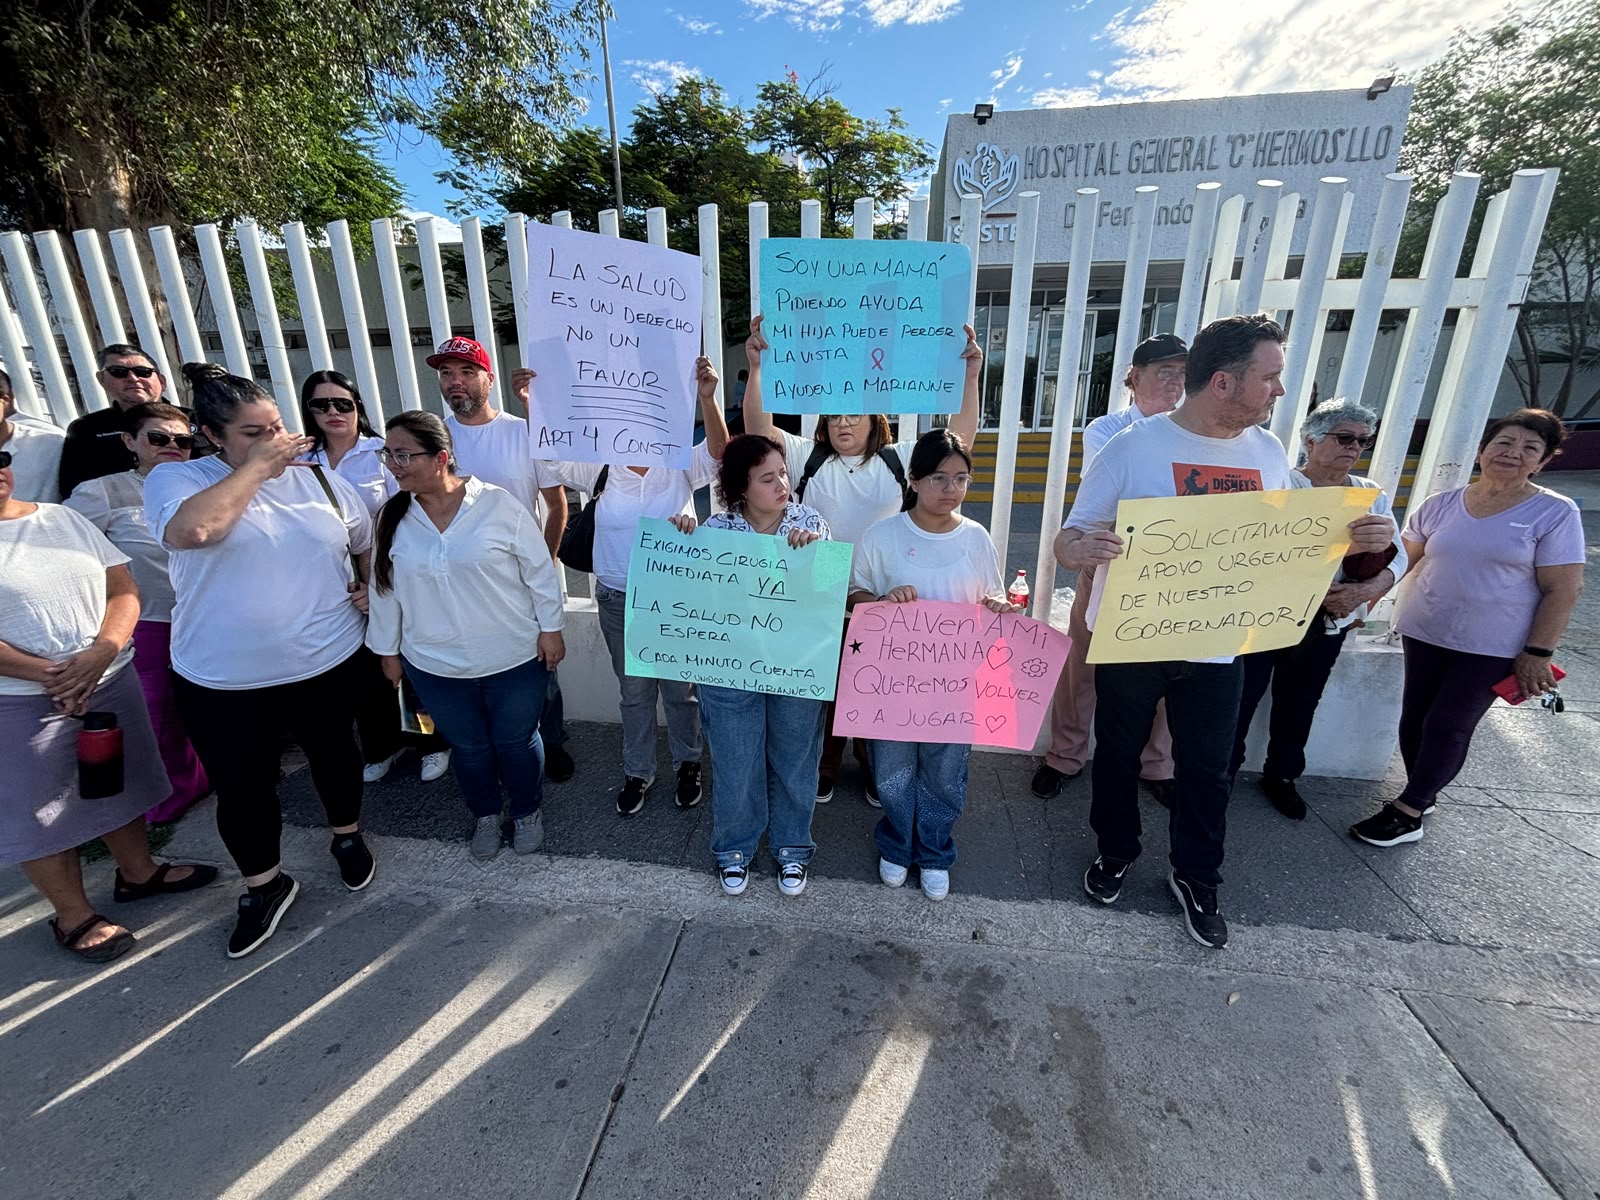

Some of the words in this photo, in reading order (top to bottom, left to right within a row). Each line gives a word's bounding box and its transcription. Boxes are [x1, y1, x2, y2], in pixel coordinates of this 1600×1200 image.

[1024, 141, 1121, 179] HOSPITAL
[1128, 135, 1219, 175] GENERAL
[1098, 198, 1194, 228] Ferndo
[549, 247, 586, 281] LA
[597, 265, 686, 301] SALUD
[775, 252, 819, 278] SOY
[827, 260, 866, 278] UNA
[873, 254, 947, 279] MAMÁ
[552, 291, 578, 308] ES
[591, 298, 613, 315] UN
[624, 306, 694, 333] DERECHO
[775, 288, 847, 312] PIDIENDO
[859, 295, 923, 312] AYUDA
[566, 325, 593, 342] NO
[610, 333, 639, 348] UN
[773, 324, 792, 339] MI
[801, 324, 836, 340] HIJA
[842, 323, 889, 339] PUEDE
[901, 324, 956, 339] PERDER
[774, 347, 796, 364] LA
[801, 347, 848, 364] VISTA
[577, 360, 668, 392] FAVOR
[775, 379, 832, 400] AYUDEN
[844, 380, 854, 394] A
[864, 377, 955, 393] MARIANNE
[538, 425, 574, 448] ART
[583, 425, 598, 452] 4
[640, 530, 712, 562] EXIGIMOS
[716, 551, 788, 573] CIRUGIA
[1126, 516, 1330, 560] ¡SOLICITAMOS
[646, 557, 740, 585] INMEDIATA
[758, 577, 785, 596] YA
[1138, 560, 1203, 582] APOYO
[1218, 545, 1325, 572] URGENTE
[632, 586, 661, 614] LA
[672, 602, 741, 626] SALUD
[751, 612, 783, 633] NO
[1120, 593, 1147, 612] DE
[1157, 580, 1254, 607] NUESTRO
[984, 614, 1002, 638] A
[1115, 593, 1316, 642] GOBERNADOR!
[660, 624, 731, 643] ESPERA
[639, 646, 677, 664] CADA
[686, 654, 742, 670] MINUTO
[749, 660, 816, 679] CUENTA
[743, 679, 809, 697] MARIANNE
[975, 679, 1041, 705] VOLVER
[873, 708, 885, 724] A
[896, 708, 981, 727] JUGAR
